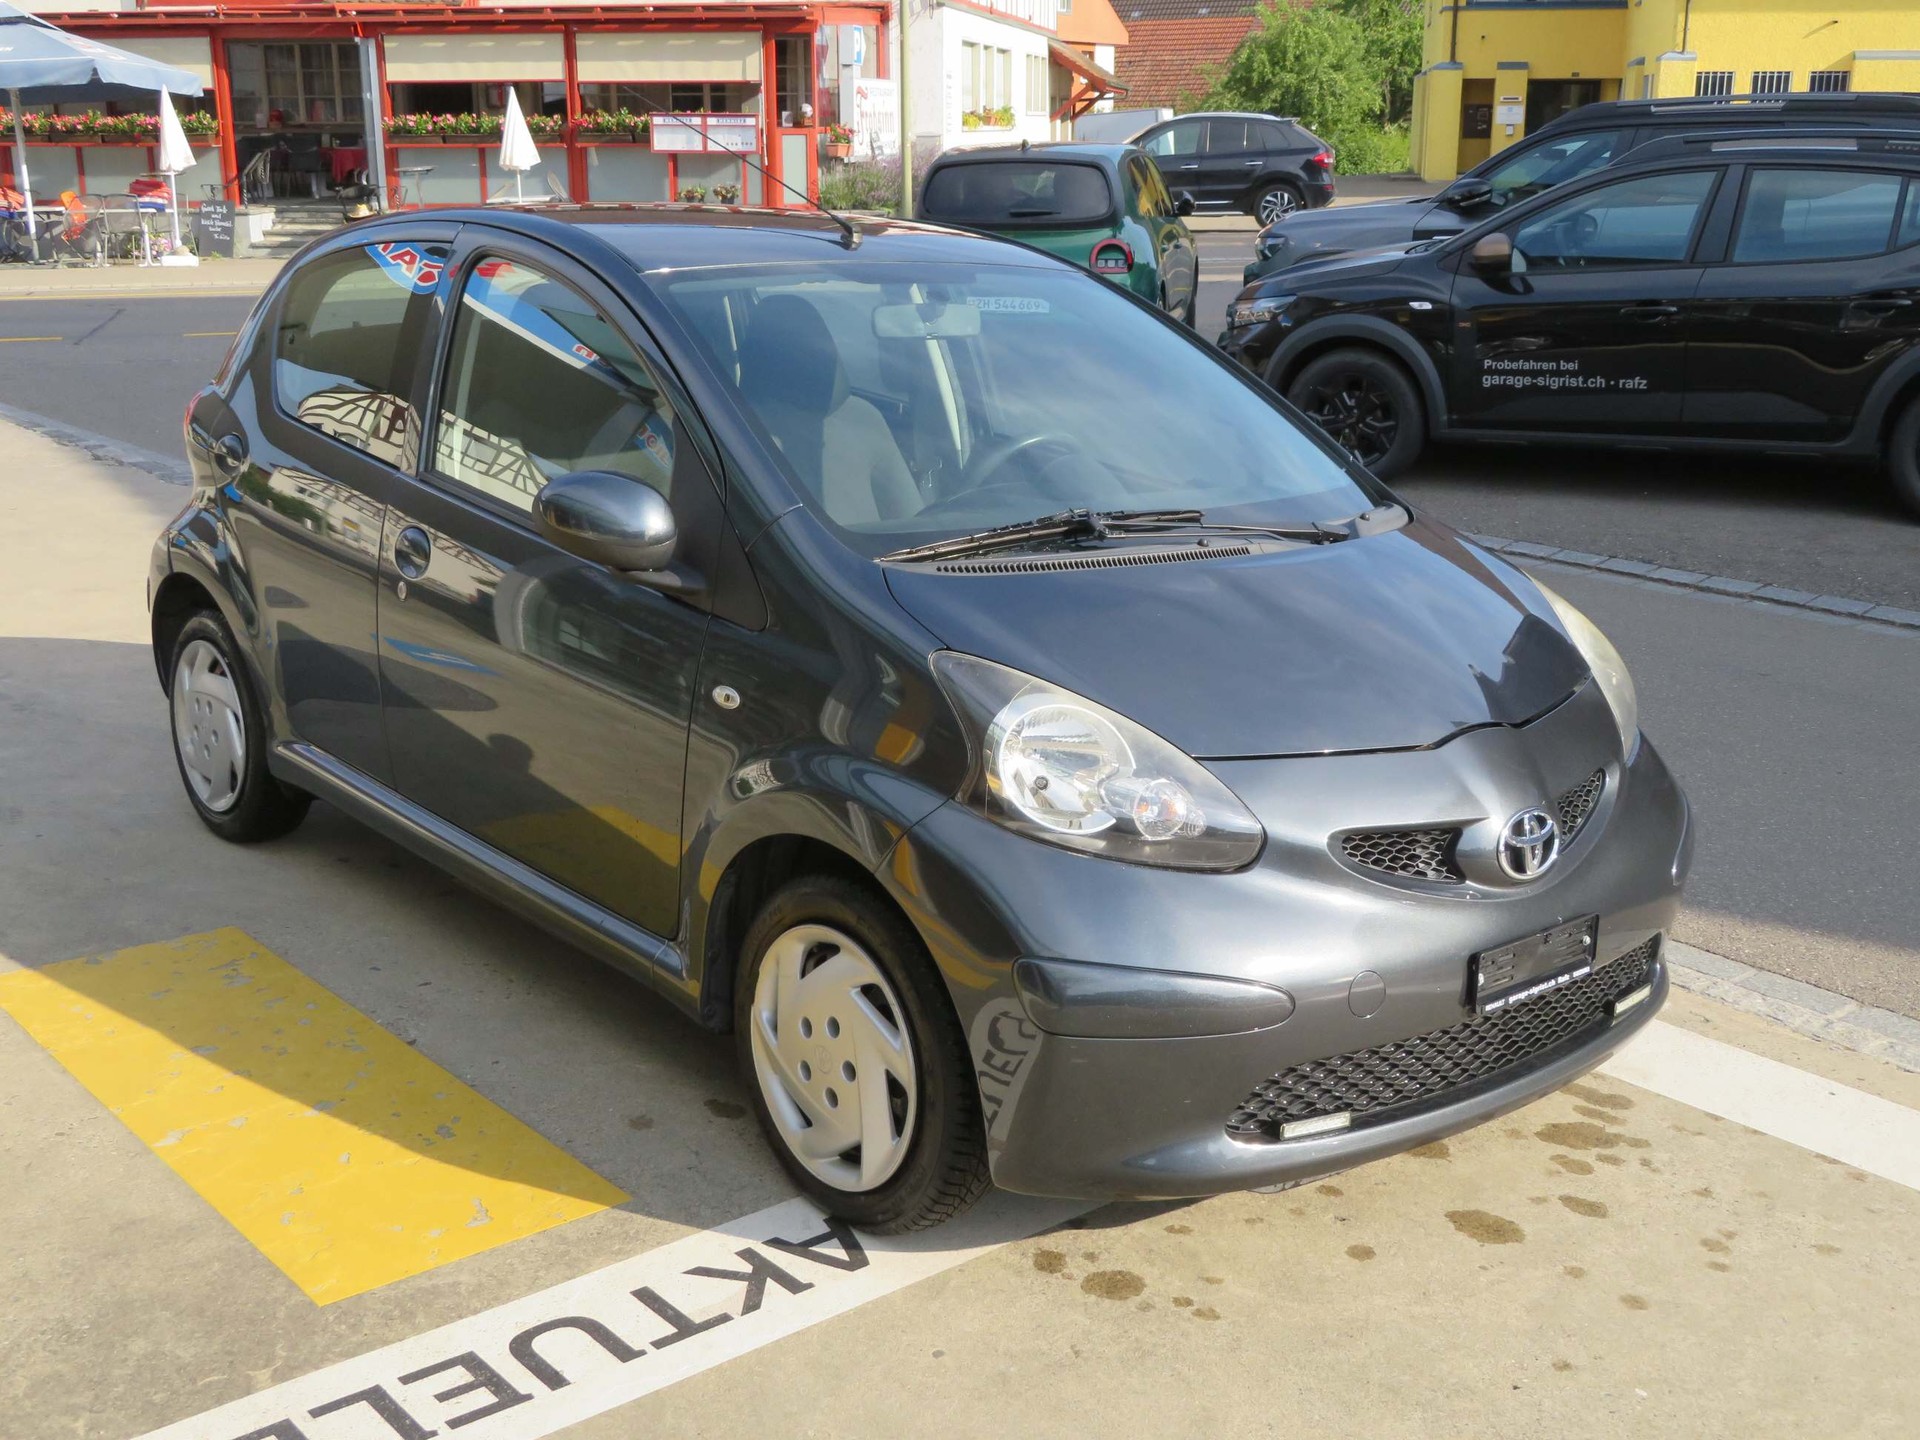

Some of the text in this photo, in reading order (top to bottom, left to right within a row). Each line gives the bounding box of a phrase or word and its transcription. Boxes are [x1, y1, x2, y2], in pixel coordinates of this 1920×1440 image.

[1484, 359, 1579, 370] Probefahren bei
[1482, 374, 1648, 389] garage-sigrist.ch rafz
